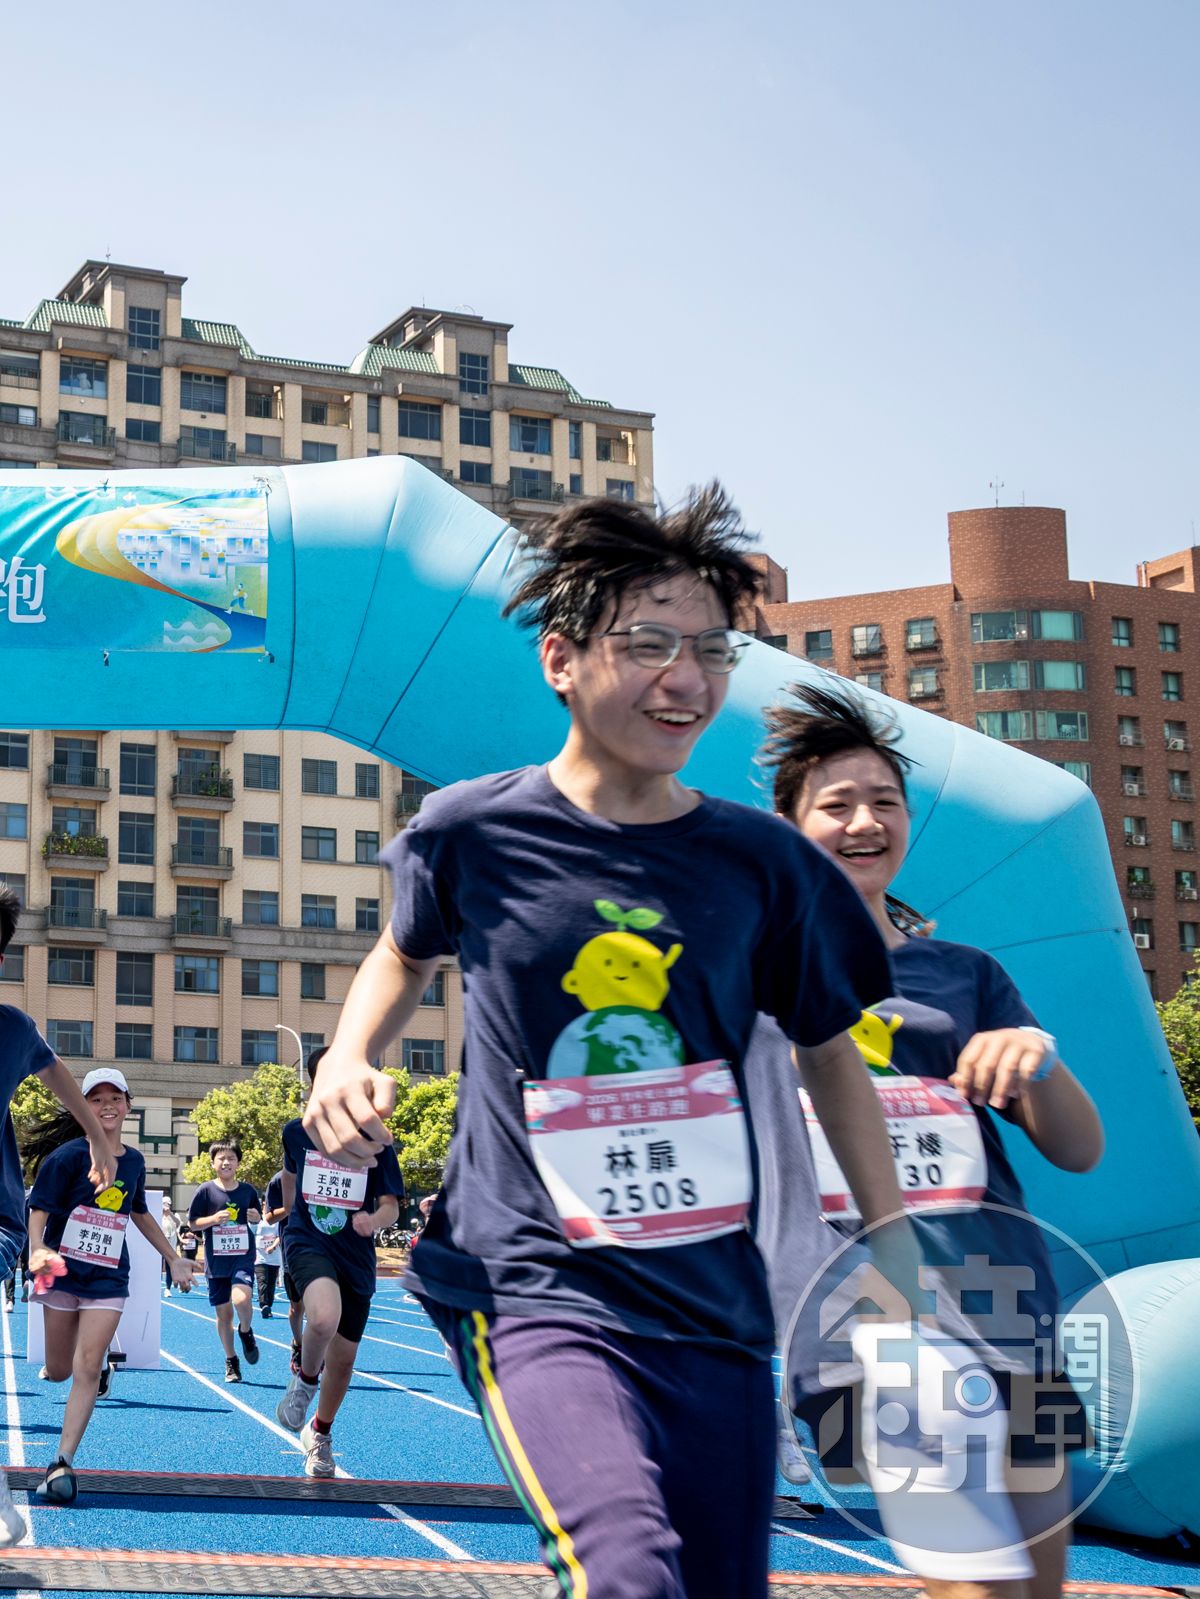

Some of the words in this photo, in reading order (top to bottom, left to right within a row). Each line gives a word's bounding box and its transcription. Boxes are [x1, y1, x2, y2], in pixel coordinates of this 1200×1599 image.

[317, 1173, 352, 1188] 王奕權
[903, 1163, 942, 1187] 30
[317, 1186, 348, 1198] 2518
[598, 1178, 700, 1216] 2508
[78, 1241, 107, 1256] 2531
